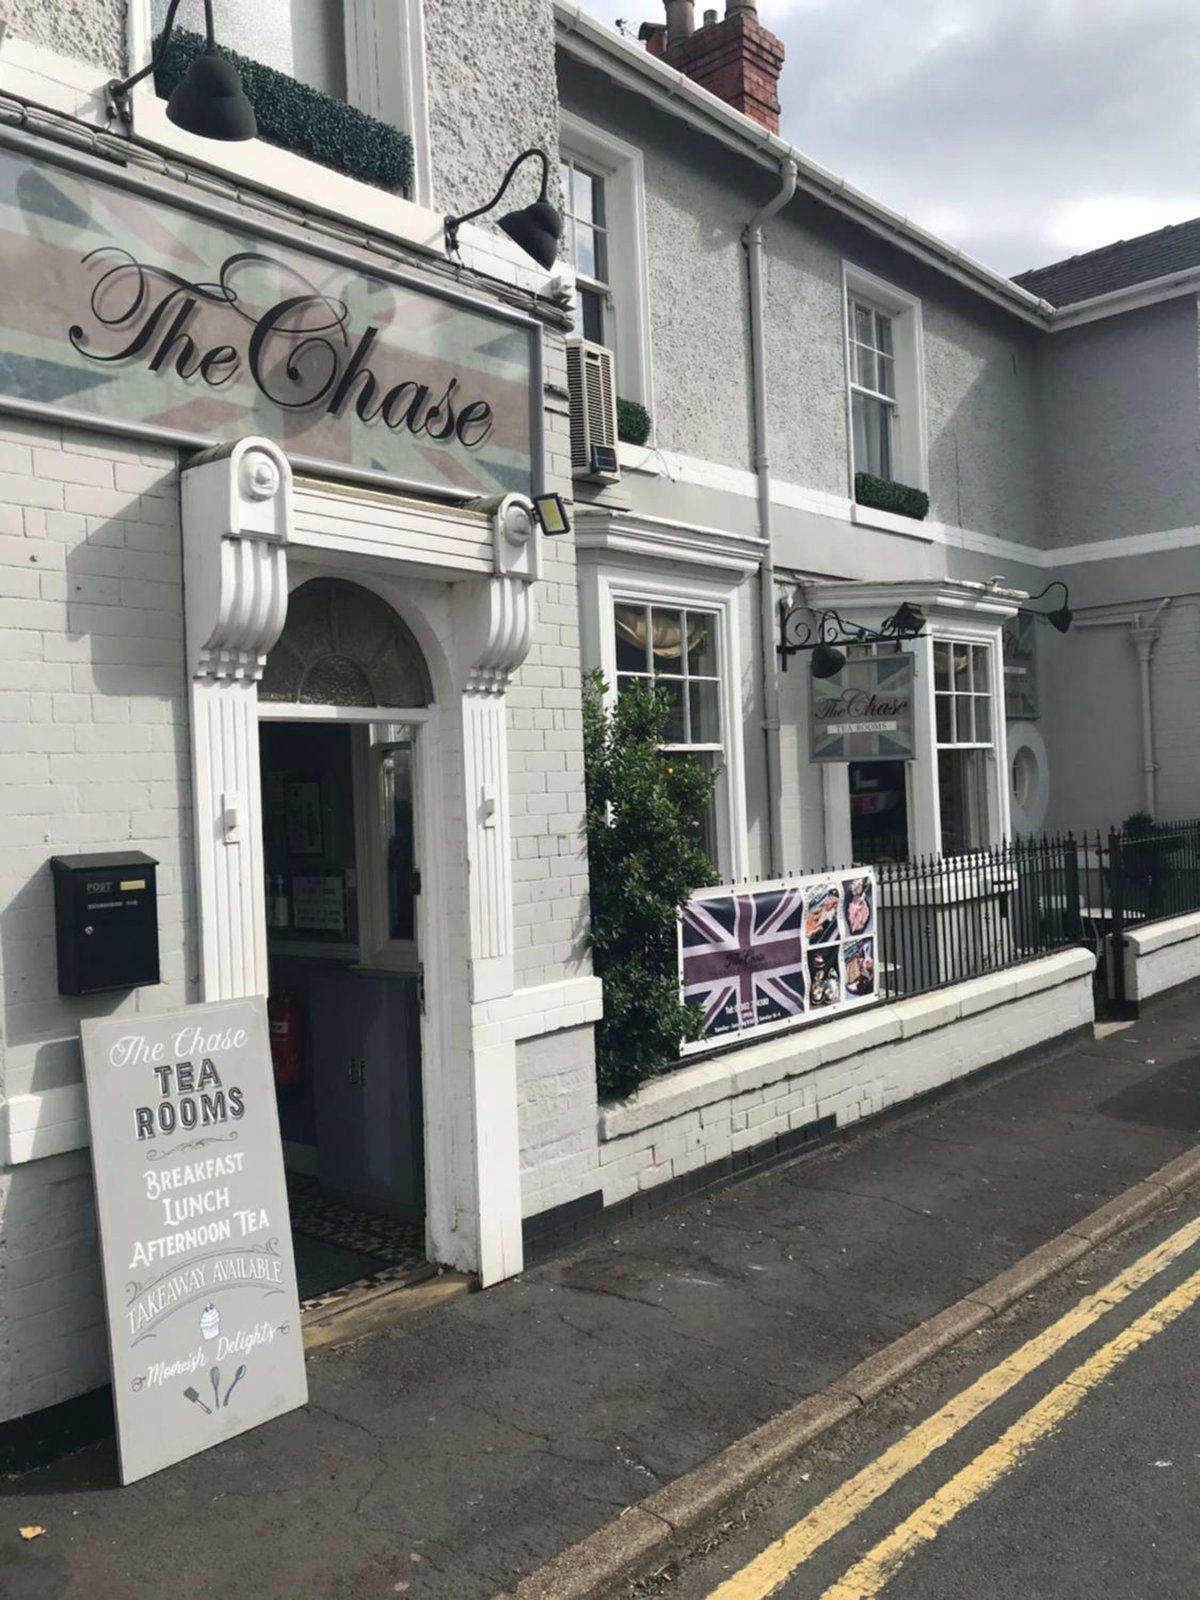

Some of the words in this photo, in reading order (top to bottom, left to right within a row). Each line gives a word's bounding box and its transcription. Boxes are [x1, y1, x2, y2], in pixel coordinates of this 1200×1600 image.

[69, 247, 238, 386] The
[220, 252, 493, 447] Chase
[815, 697, 846, 719] The
[841, 687, 908, 718] Chase
[836, 725, 853, 733] TEA
[855, 722, 887, 732] ROOMS
[86, 881, 113, 892] POST
[110, 1035, 164, 1067] The
[171, 1027, 248, 1058] Chase
[154, 1058, 222, 1098] TEA
[135, 1087, 246, 1141] ROOMS
[144, 1152, 245, 1200] BREAKFAST
[162, 1187, 230, 1226] LUNCH
[128, 1219, 231, 1270] AFTERNOON
[233, 1208, 271, 1237] TEA
[126, 1265, 206, 1334] TAKEAWAY
[212, 1257, 283, 1284] AVAILABLE
[216, 1319, 276, 1361] Delights
